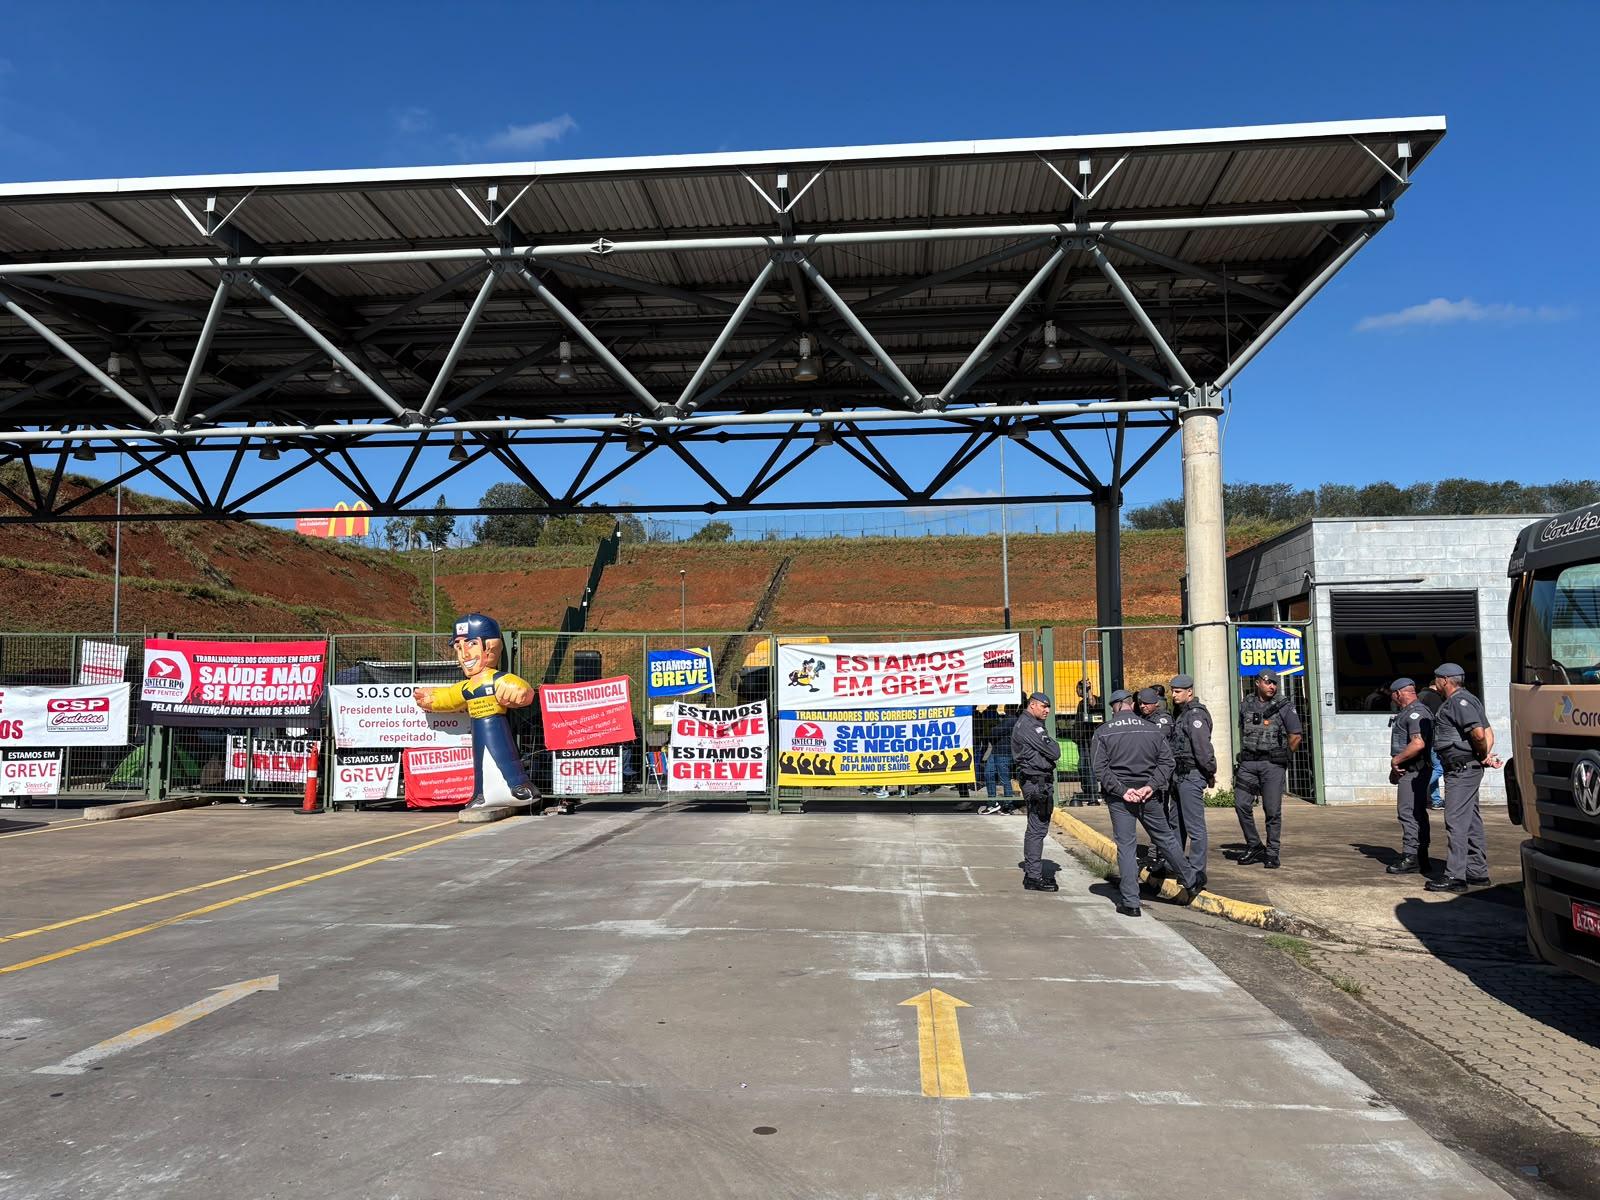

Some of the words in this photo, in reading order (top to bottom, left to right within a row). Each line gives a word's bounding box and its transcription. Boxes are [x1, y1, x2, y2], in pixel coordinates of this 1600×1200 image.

[1240, 638, 1284, 649] ESTAMOS
[1285, 638, 1300, 650] EM
[195, 655, 245, 664] TRABALHADORES
[836, 650, 966, 673] ESTAMOS
[1240, 650, 1301, 665] GREVE
[651, 660, 692, 671] ESTAMOS
[694, 658, 706, 669] EM
[199, 664, 267, 685] SAÚDE
[272, 664, 317, 684] NÃO
[651, 669, 708, 687] GREVE
[144, 679, 167, 688] SINTECT
[833, 676, 873, 696] EM
[881, 673, 969, 695] GREVE
[202, 685, 224, 701] SE
[228, 684, 313, 701] NEGOCIA!
[356, 687, 390, 698] S.O.S
[547, 684, 624, 704] INTERSINDICAL
[51, 700, 105, 710] CSP
[151, 703, 172, 712] PELA
[173, 704, 230, 715] MANUTENÇÃO
[231, 707, 243, 715] DO
[243, 707, 271, 715] PLANO
[272, 706, 283, 715] DE
[284, 705, 311, 715] SAÚDE
[340, 705, 392, 714] Presidente
[396, 705, 418, 716] Lula,
[678, 703, 762, 721] ESTAMOS
[797, 711, 862, 721] TRABALHADORES
[864, 711, 879, 720] DOS
[882, 709, 917, 720] CORREIOS
[919, 709, 927, 719] EM
[928, 706, 955, 718] GREVE
[52, 713, 104, 725] Conlutas
[359, 719, 400, 728] Correios
[402, 719, 430, 729] forte,
[433, 720, 458, 729] povo
[677, 718, 765, 739] GREVE
[836, 723, 906, 739] SAÚDE
[912, 720, 957, 737] NÃO
[379, 732, 436, 743] respeitado!
[833, 740, 858, 753] SE
[864, 735, 960, 753] NEGOCIA!
[43, 751, 56, 759] EM
[562, 749, 599, 757] ESTAMOS
[673, 747, 762, 759] ESTAMOS
[861, 754, 909, 763] MANUTENÇÃO
[343, 756, 379, 764] ESTAMOS
[888, 761, 911, 771] SAÚDE
[5, 763, 57, 778] GREVE
[340, 767, 394, 782] GREVE
[560, 760, 616, 776] GREVE
[673, 762, 763, 779] GREVE
